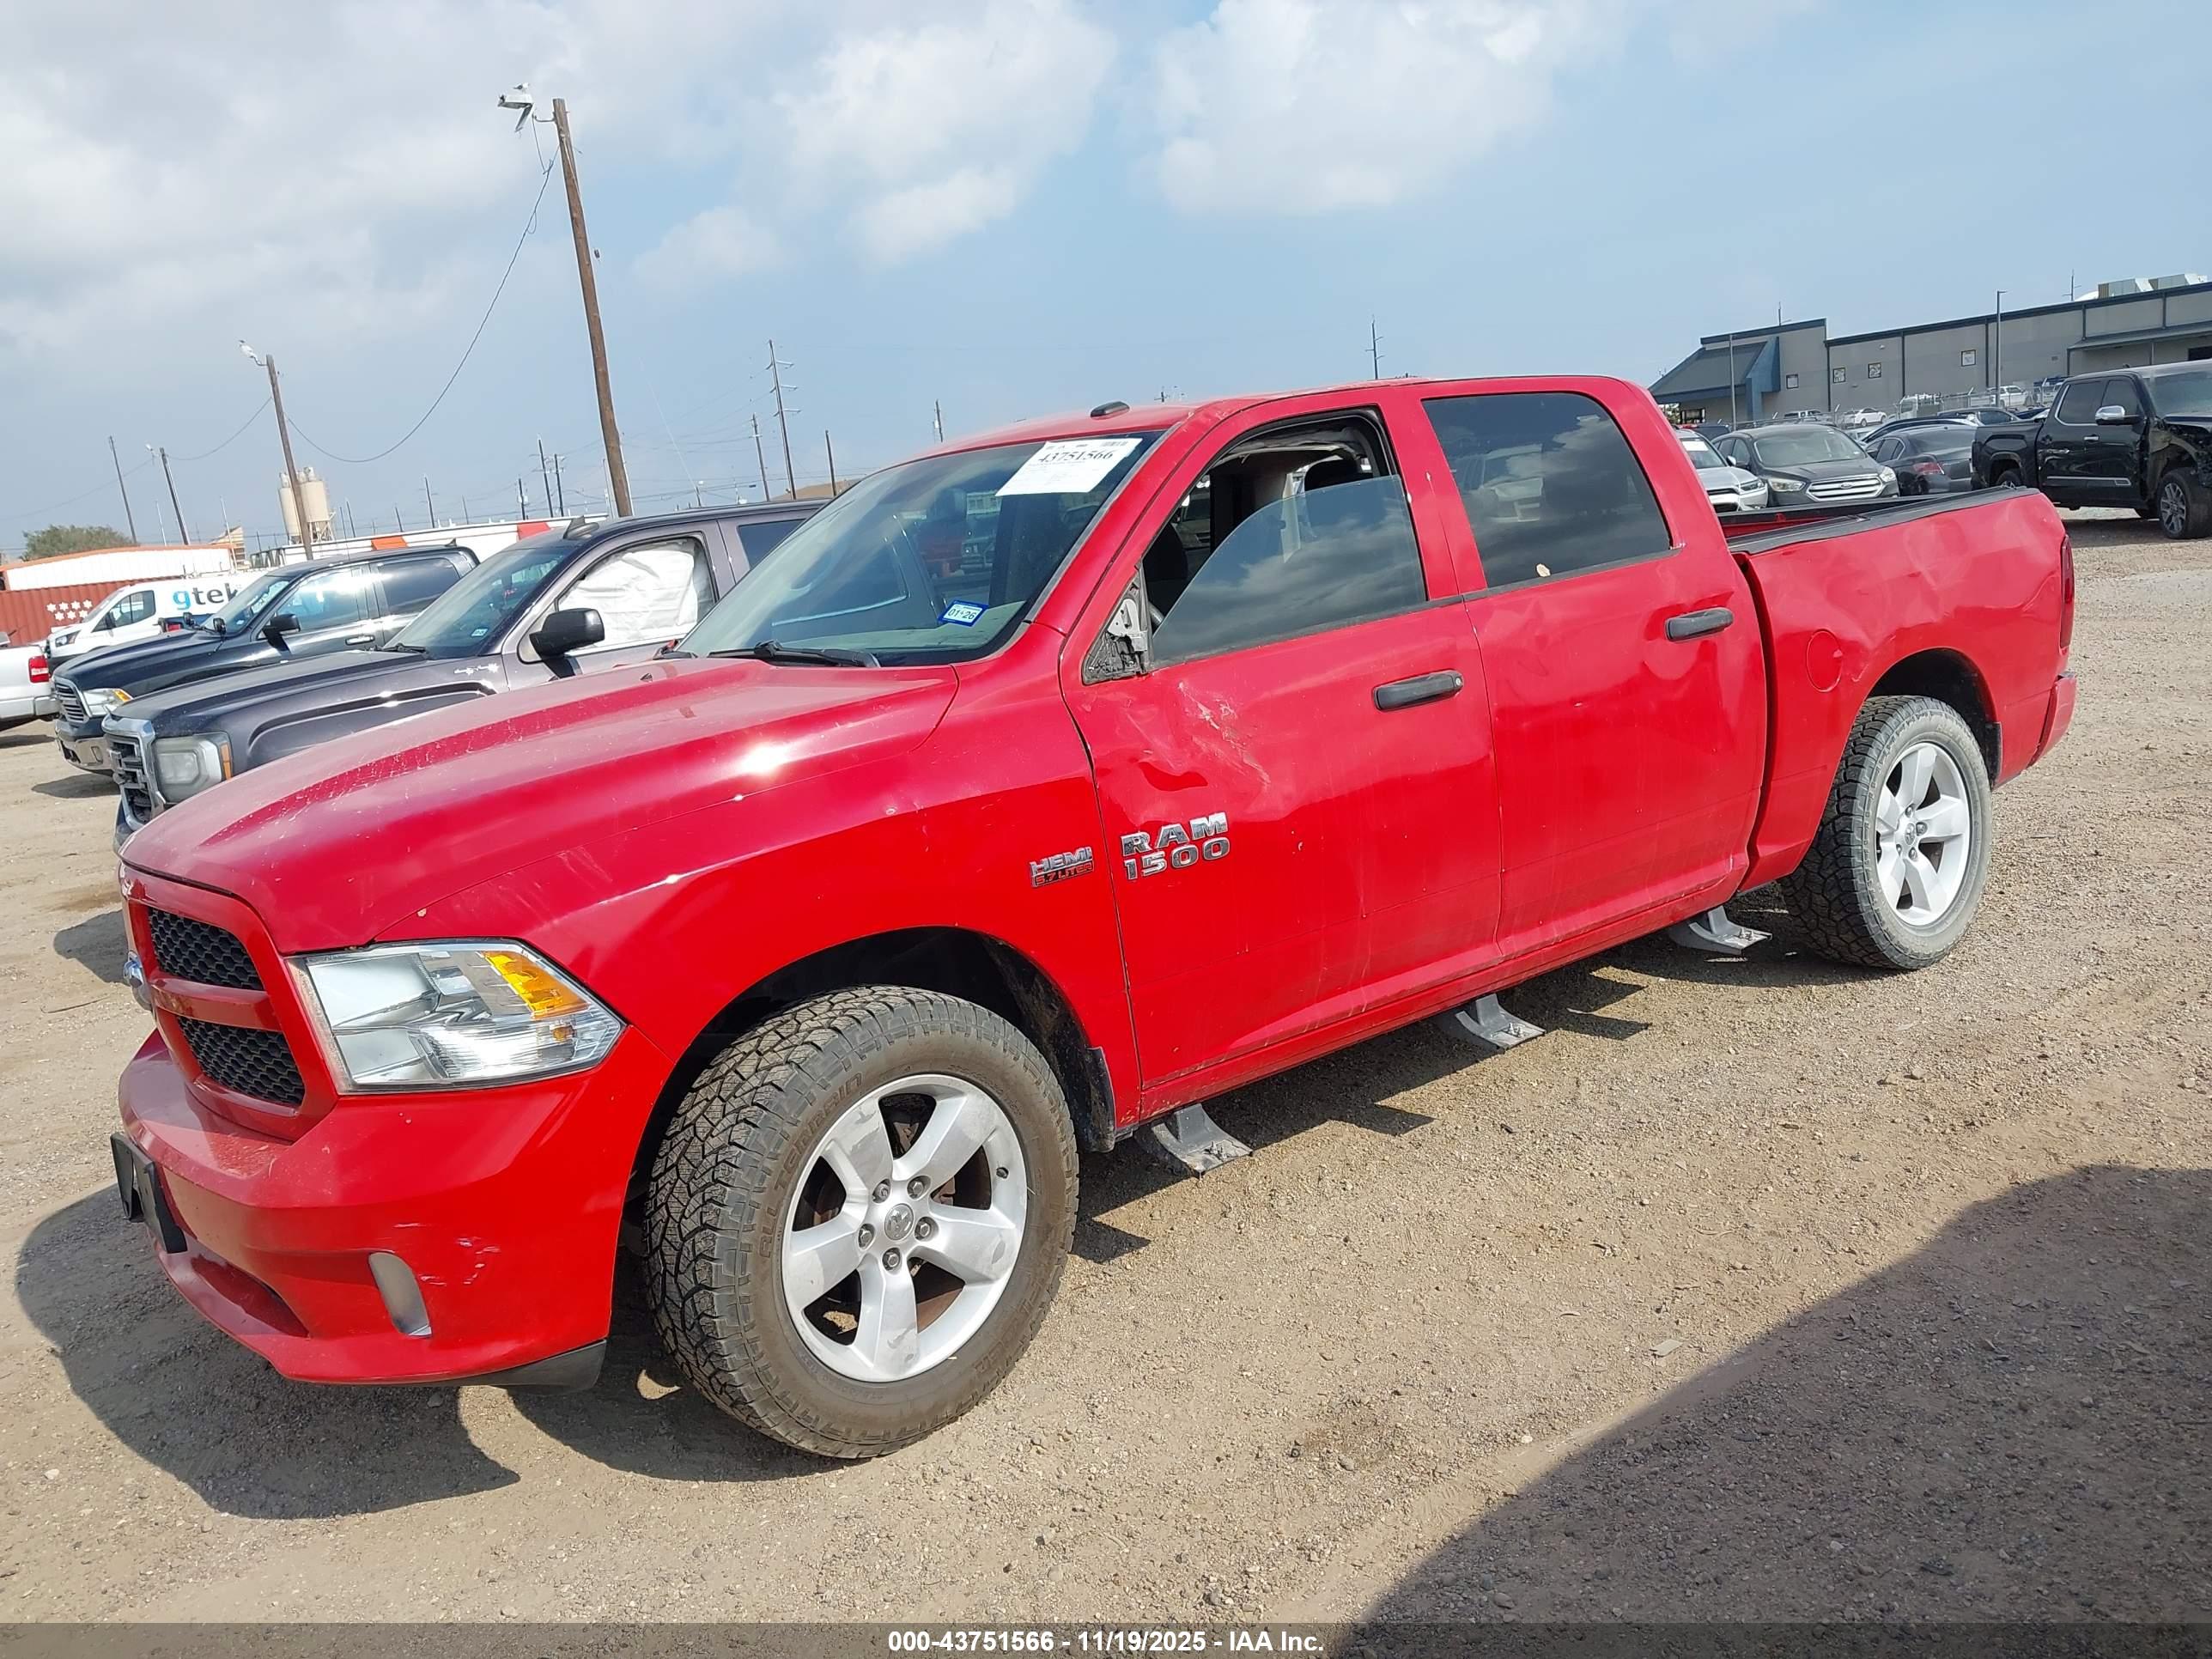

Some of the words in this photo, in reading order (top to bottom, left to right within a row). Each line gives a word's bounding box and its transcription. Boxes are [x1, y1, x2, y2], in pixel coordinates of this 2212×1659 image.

[1038, 449, 1115, 463] 43751566
[1120, 811, 1229, 856] RAM
[1029, 846, 1093, 875] HEMI
[1035, 872, 1057, 885] 5.7
[1057, 861, 1093, 879] LITER
[1124, 837, 1230, 880] 1500
